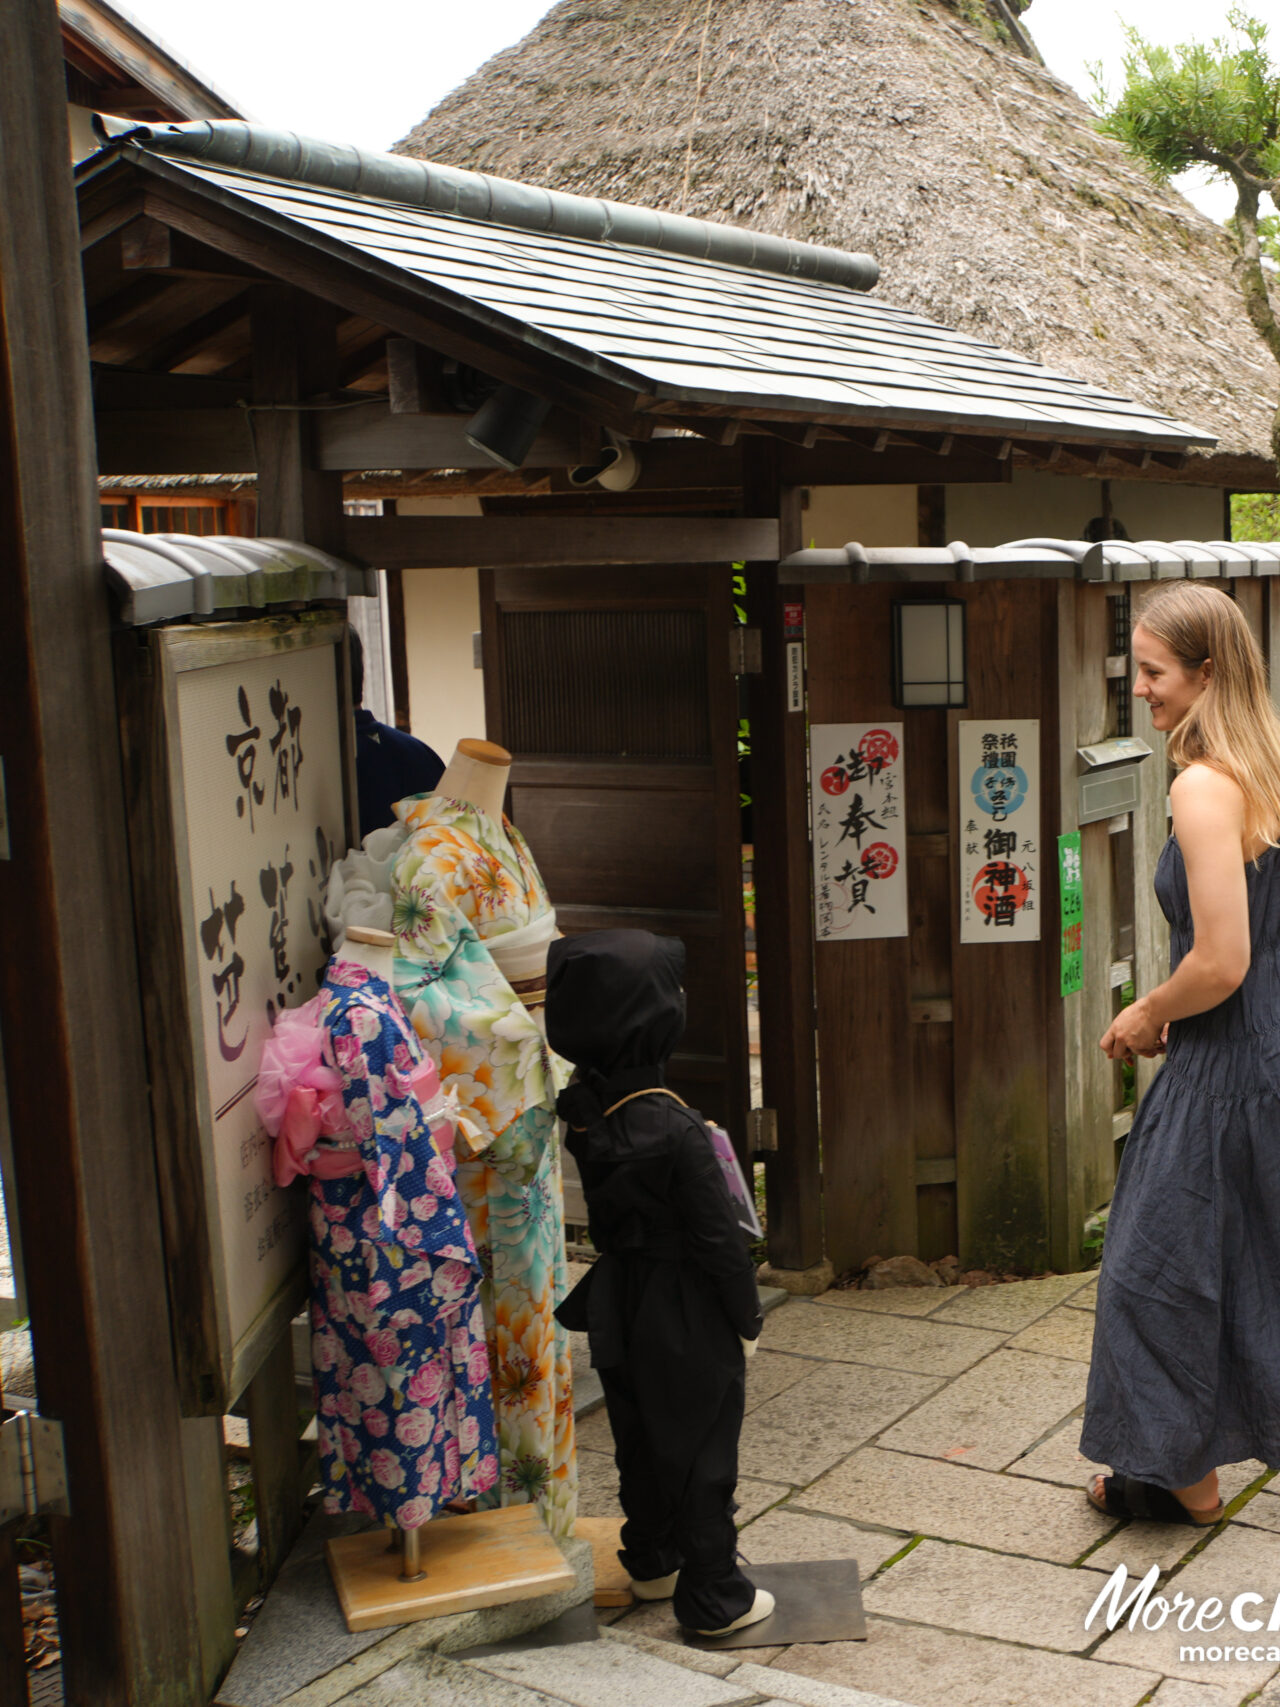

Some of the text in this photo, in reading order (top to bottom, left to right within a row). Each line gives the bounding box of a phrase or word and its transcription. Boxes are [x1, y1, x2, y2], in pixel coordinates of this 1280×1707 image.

[226, 678, 303, 833] 京都
[983, 828, 1017, 927] 御神酒
